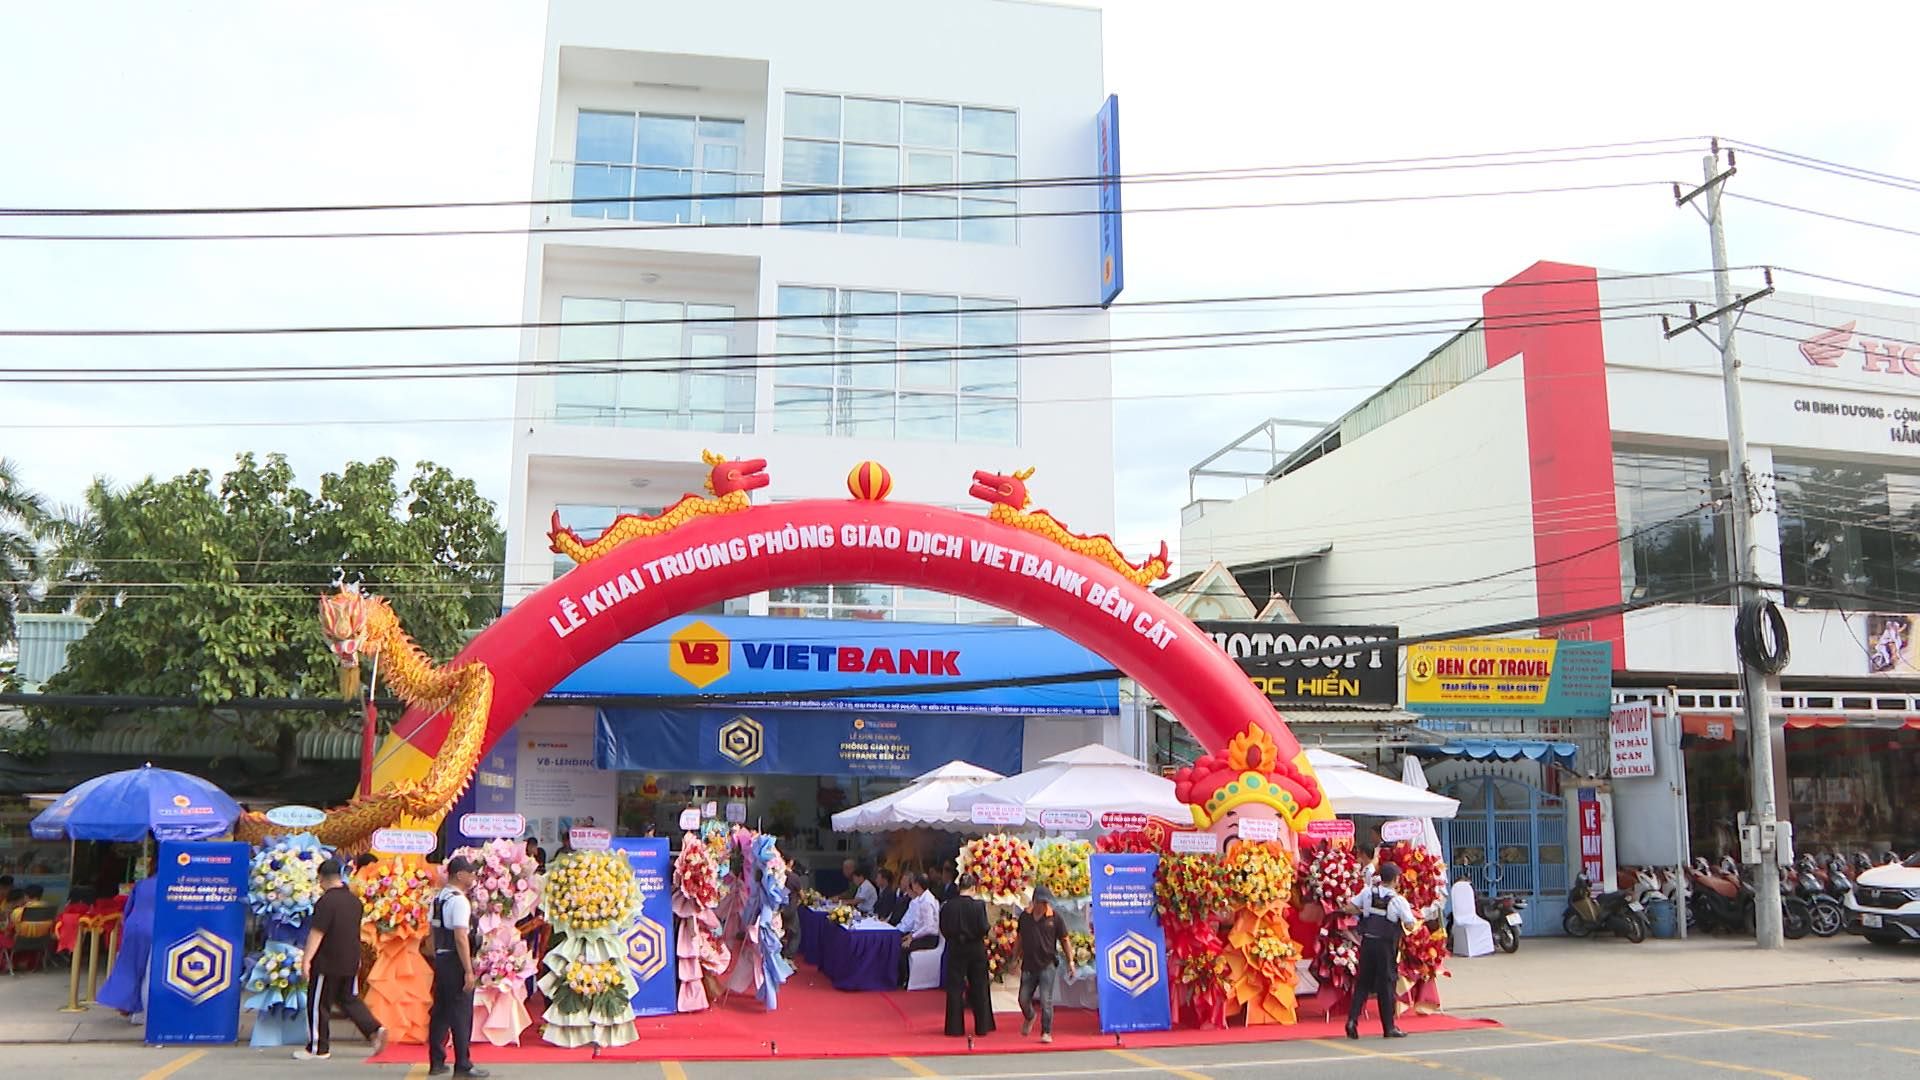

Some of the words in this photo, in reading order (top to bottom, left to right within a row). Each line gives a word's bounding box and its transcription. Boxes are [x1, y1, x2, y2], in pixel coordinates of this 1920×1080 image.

[550, 597, 586, 638] LỄ
[581, 569, 645, 618] KHAI
[644, 537, 747, 584] TRƯƠNG
[748, 522, 834, 557] PHÒNG
[841, 525, 900, 549] GIAO
[906, 529, 962, 563] DỊCH
[970, 540, 1089, 597] VIETBANK
[1133, 611, 1178, 650] CÁT
[679, 640, 720, 665] VB
[742, 642, 961, 676] VIETBANK
[1205, 632, 1389, 669] HOTOCOPY
[1437, 658, 1464, 675] BEN
[1469, 658, 1496, 676] CAT
[1500, 659, 1551, 677] TRAVEL
[1298, 669, 1360, 696] HIỂN
[1615, 740, 1625, 748] IN
[1616, 751, 1642, 761] SCAN
